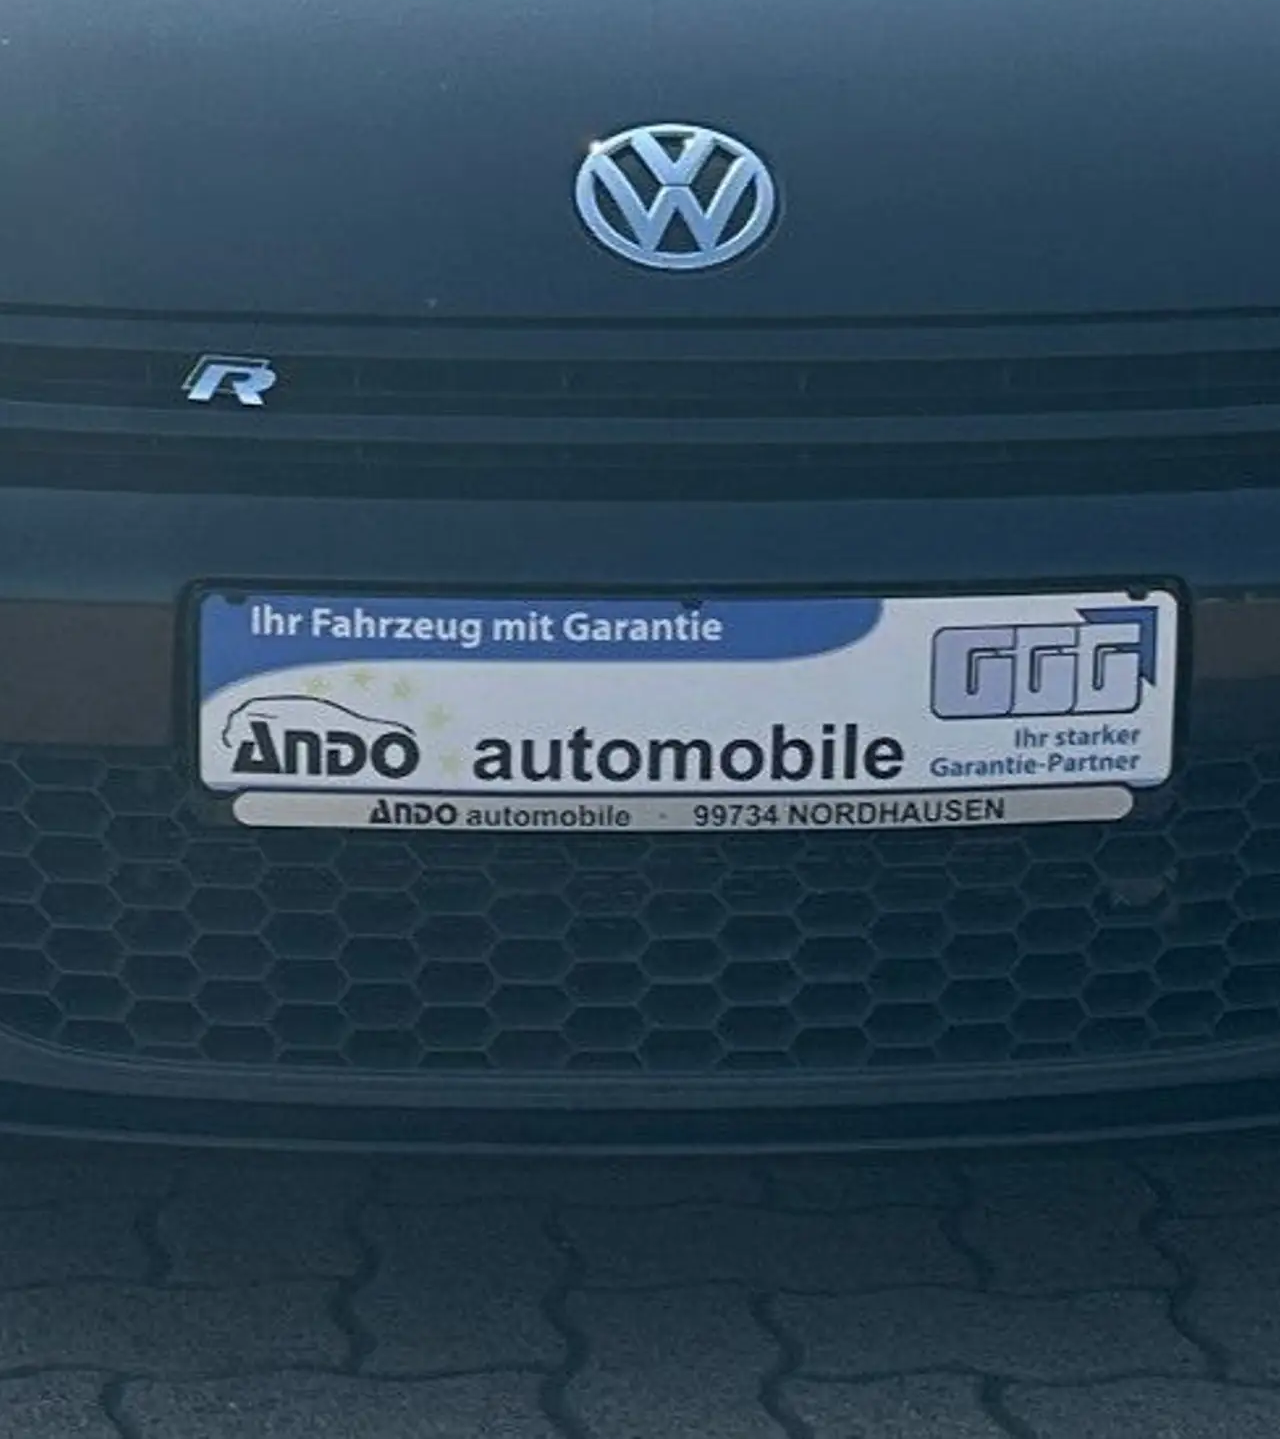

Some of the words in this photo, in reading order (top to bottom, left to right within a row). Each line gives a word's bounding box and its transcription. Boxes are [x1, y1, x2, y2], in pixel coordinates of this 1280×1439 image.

[182, 354, 277, 405] R
[251, 605, 304, 636] Ihr
[312, 608, 482, 648] Fahrzeug
[493, 611, 553, 642] mit
[562, 611, 724, 643] Garantie
[473, 723, 904, 782] automobile
[1015, 727, 1049, 749] Ihr
[1055, 724, 1141, 748] starker
[929, 752, 1142, 778] Garantie-Partner
[466, 804, 631, 828] automobile
[694, 803, 780, 827] 99734
[787, 797, 1006, 826] NORDHAUSEN
